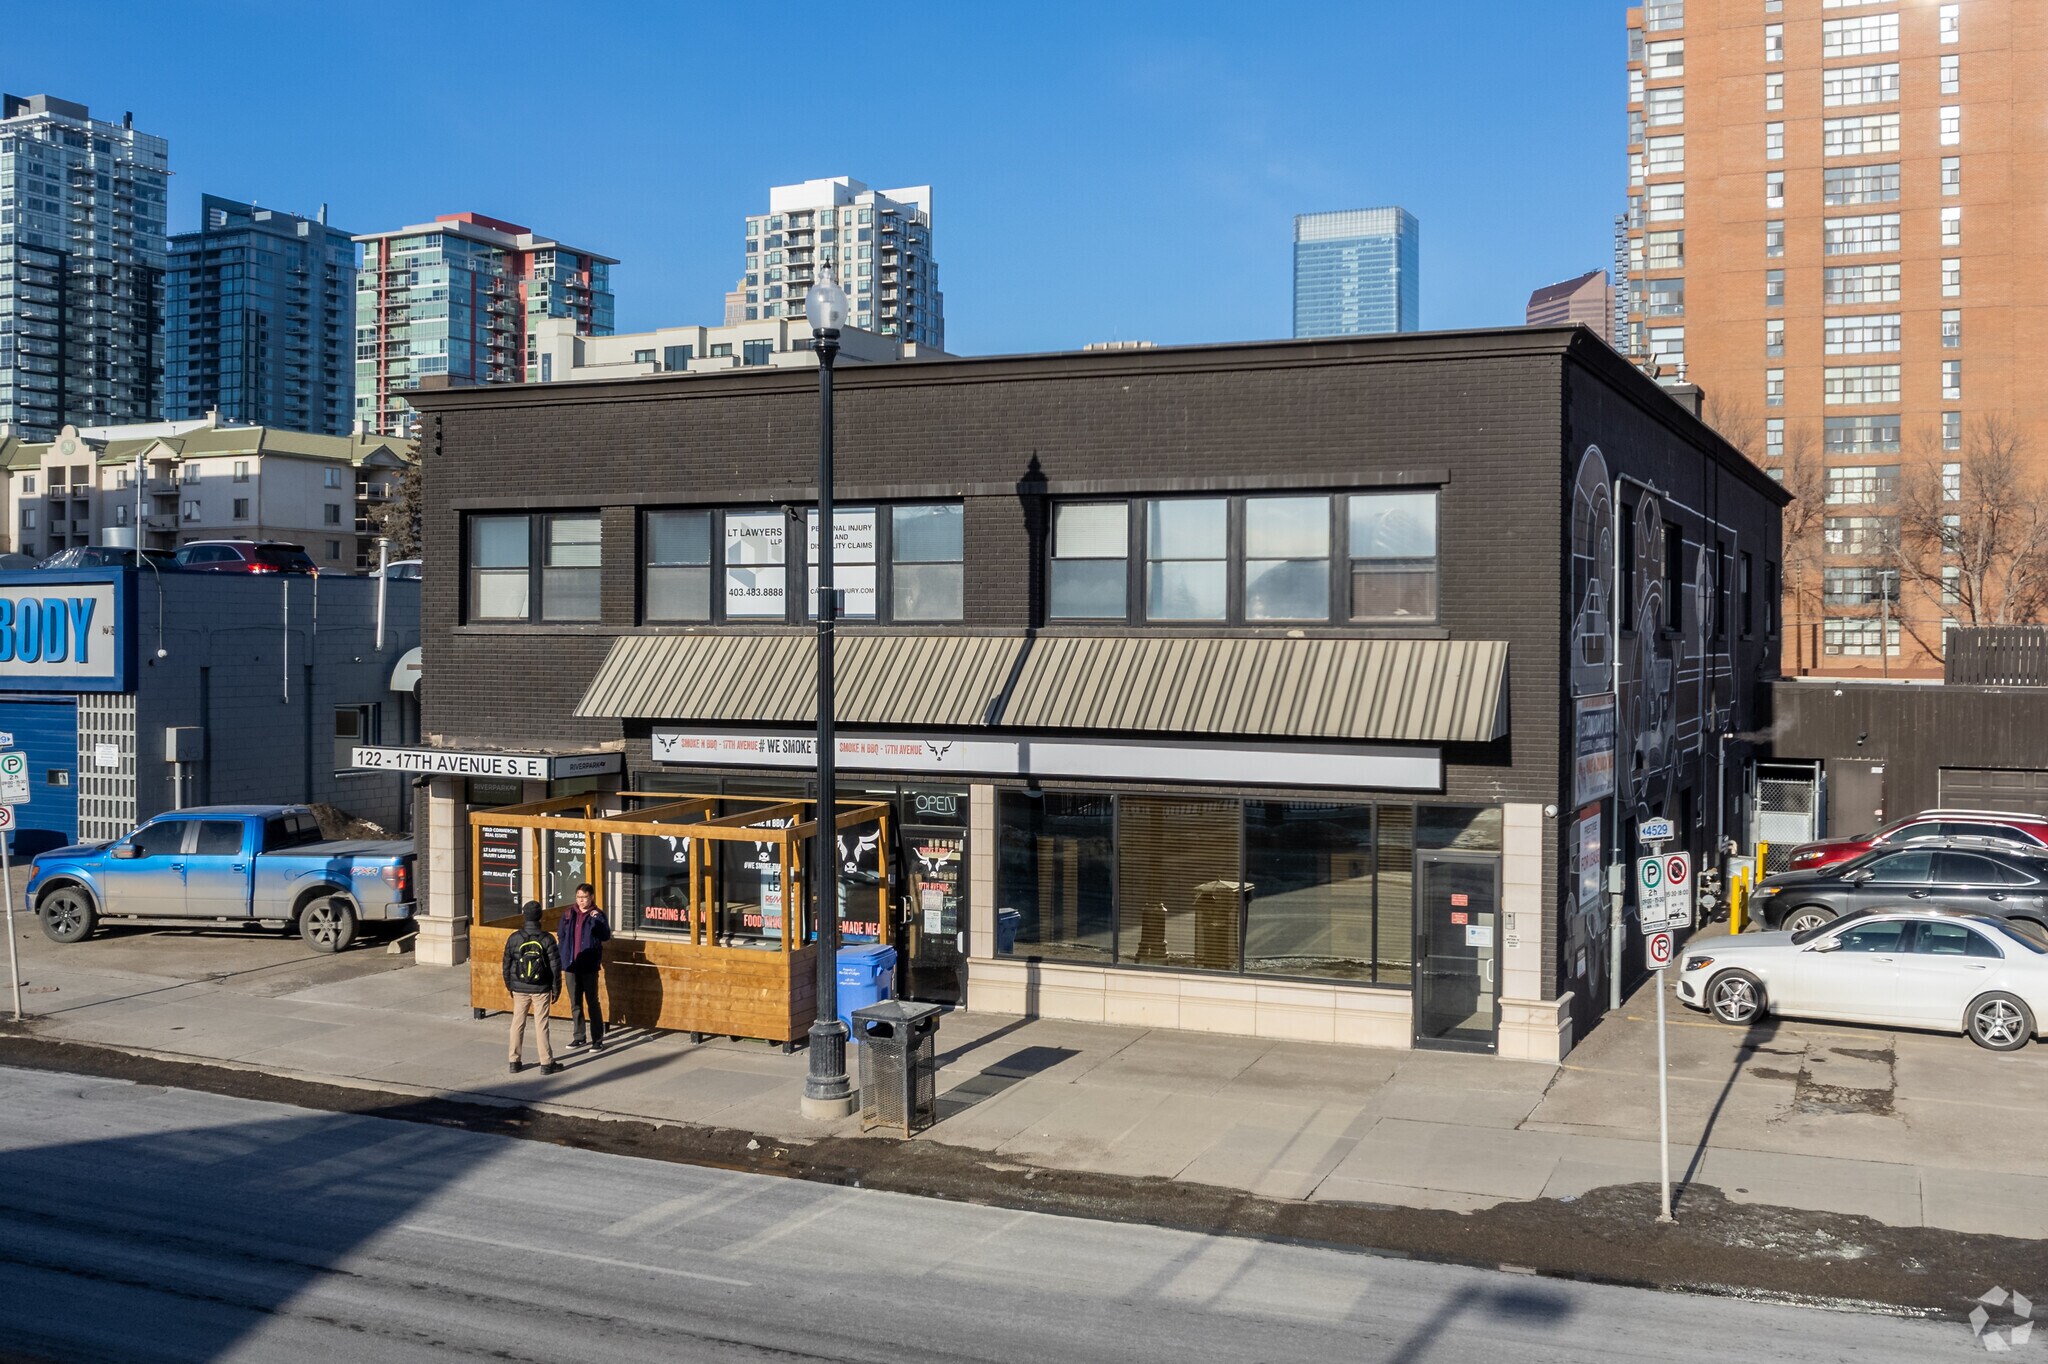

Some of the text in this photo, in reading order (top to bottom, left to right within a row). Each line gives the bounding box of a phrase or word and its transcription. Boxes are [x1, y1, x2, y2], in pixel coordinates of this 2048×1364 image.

[727, 528, 783, 537] LT LAWYERS
[728, 588, 783, 597] 403.483.8888
[0, 597, 97, 664] BODY
[681, 738, 700, 749] SMOKE
[706, 740, 718, 751] BBQ
[723, 740, 736, 750] 17TH
[736, 741, 758, 751] AVENUE
[759, 739, 765, 753] #
[767, 739, 780, 753] WE
[783, 740, 812, 754] SMOKE
[840, 742, 859, 753] SMOKE
[861, 743, 866, 753] N
[867, 744, 878, 755] BBQ
[885, 744, 898, 755] 17TH
[899, 745, 922, 756] AVENUE
[358, 751, 382, 766] 122
[396, 753, 432, 769] 17TH
[437, 756, 502, 773] AVENUE
[507, 759, 522, 775] S.
[527, 760, 541, 777] E.
[570, 761, 601, 772] RIVERPARK
[474, 783, 510, 792] RIVERPARK
[916, 795, 956, 811] OPEN
[772, 818, 785, 829] BBQ
[1647, 824, 1668, 836] 4529
[645, 906, 678, 921] CATERING
[680, 909, 686, 922] &
[743, 914, 762, 928] FOOD
